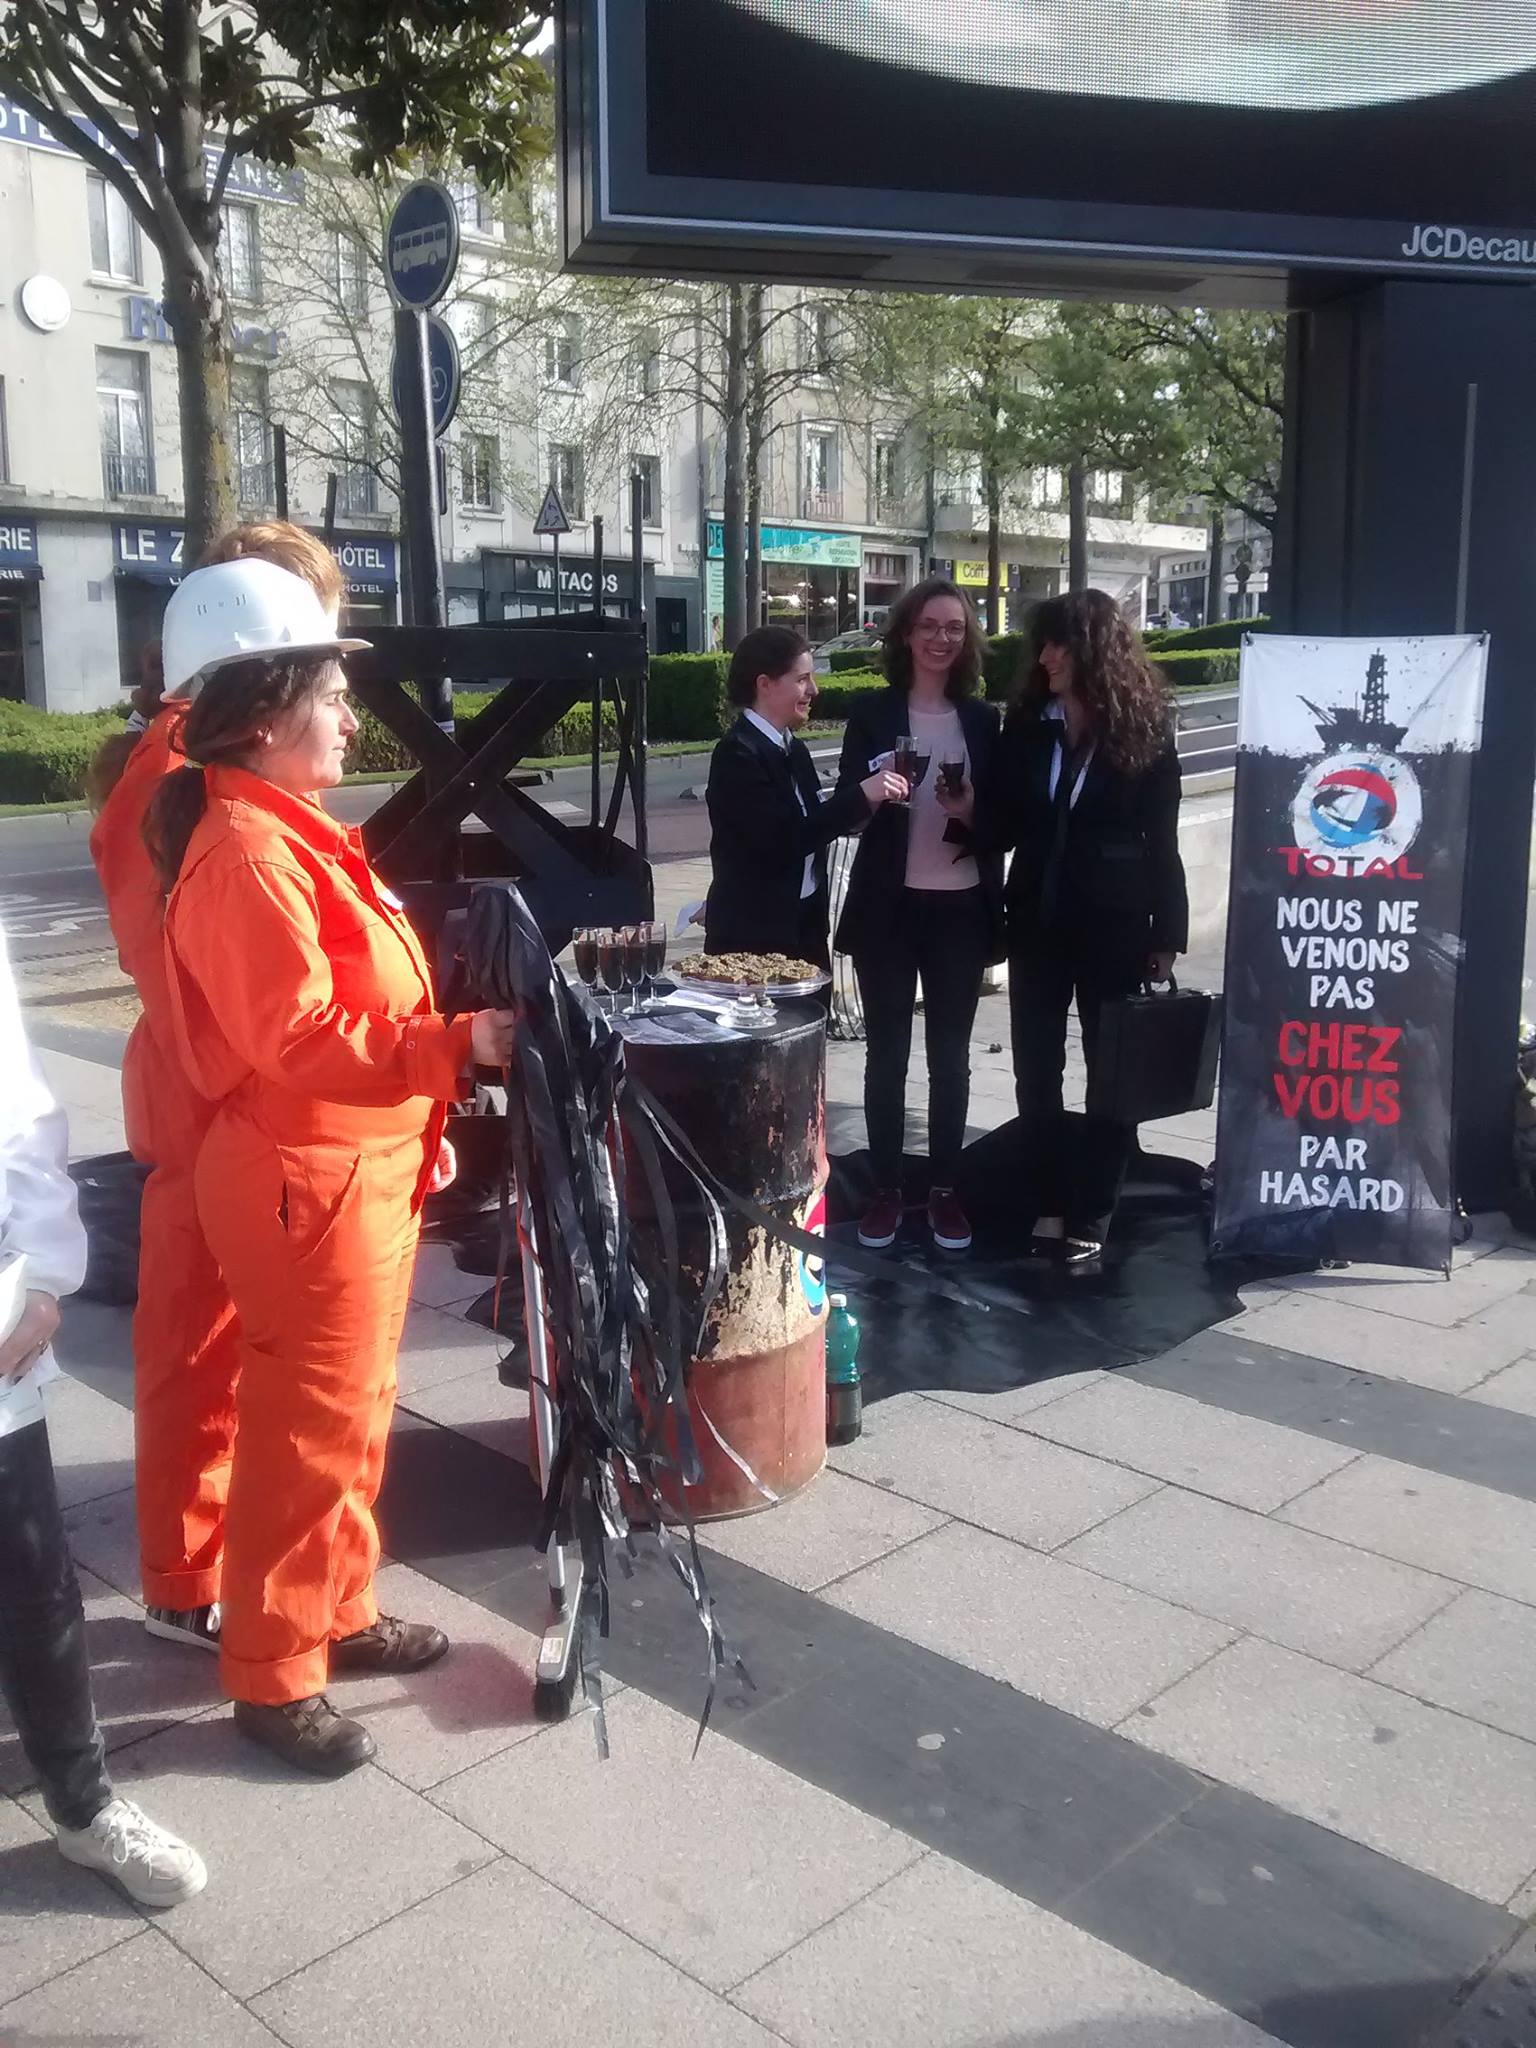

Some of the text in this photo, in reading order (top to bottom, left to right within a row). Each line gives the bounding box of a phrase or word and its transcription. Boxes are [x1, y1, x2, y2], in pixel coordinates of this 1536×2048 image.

[120, 528, 157, 561] LE
[1277, 846, 1425, 880] TOTAL
[1276, 896, 1419, 934] NOUS NE
[1281, 935, 1410, 973] VENONS
[1309, 975, 1375, 1010] PAS
[1278, 1020, 1402, 1073] CHEZ
[1273, 1073, 1401, 1126] VOUS
[1299, 1135, 1368, 1171] PAR
[1259, 1170, 1404, 1213] HASARD
